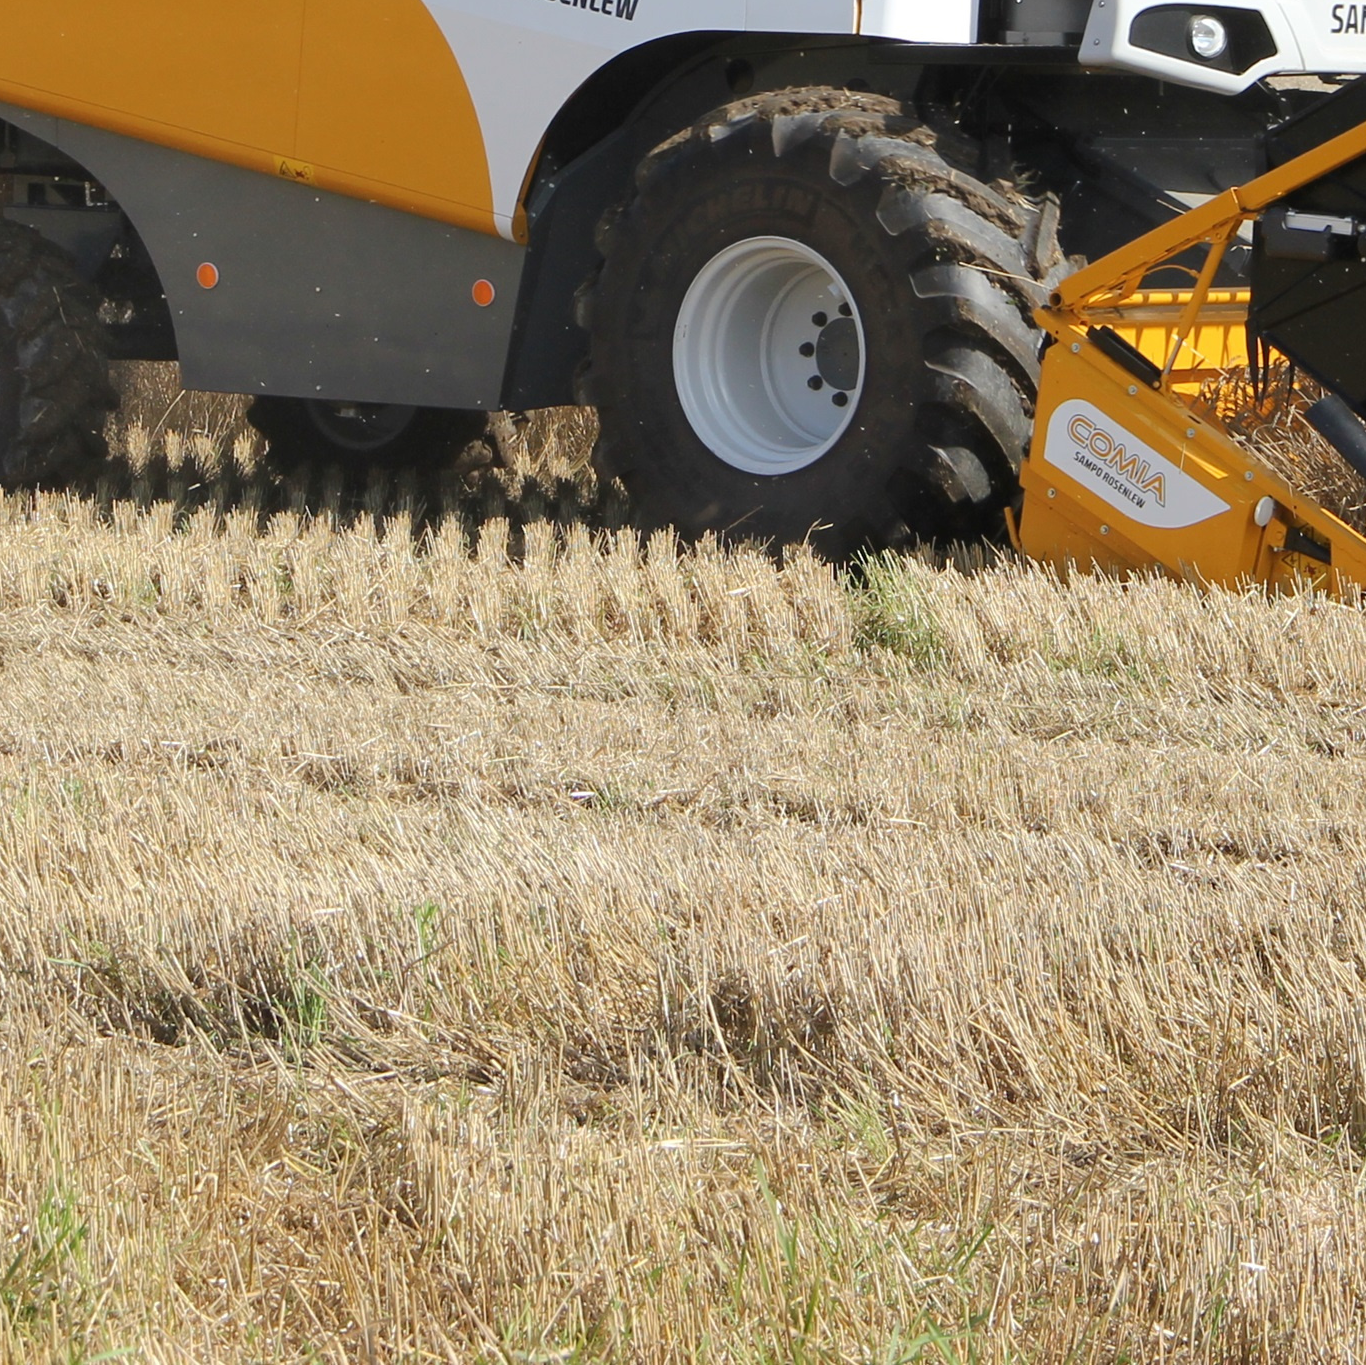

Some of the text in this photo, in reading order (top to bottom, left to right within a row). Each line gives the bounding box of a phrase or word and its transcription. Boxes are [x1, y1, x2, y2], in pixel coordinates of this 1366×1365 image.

[1067, 413, 1166, 508] COMIA
[1073, 450, 1146, 509] SAMPO ROSENLEW
